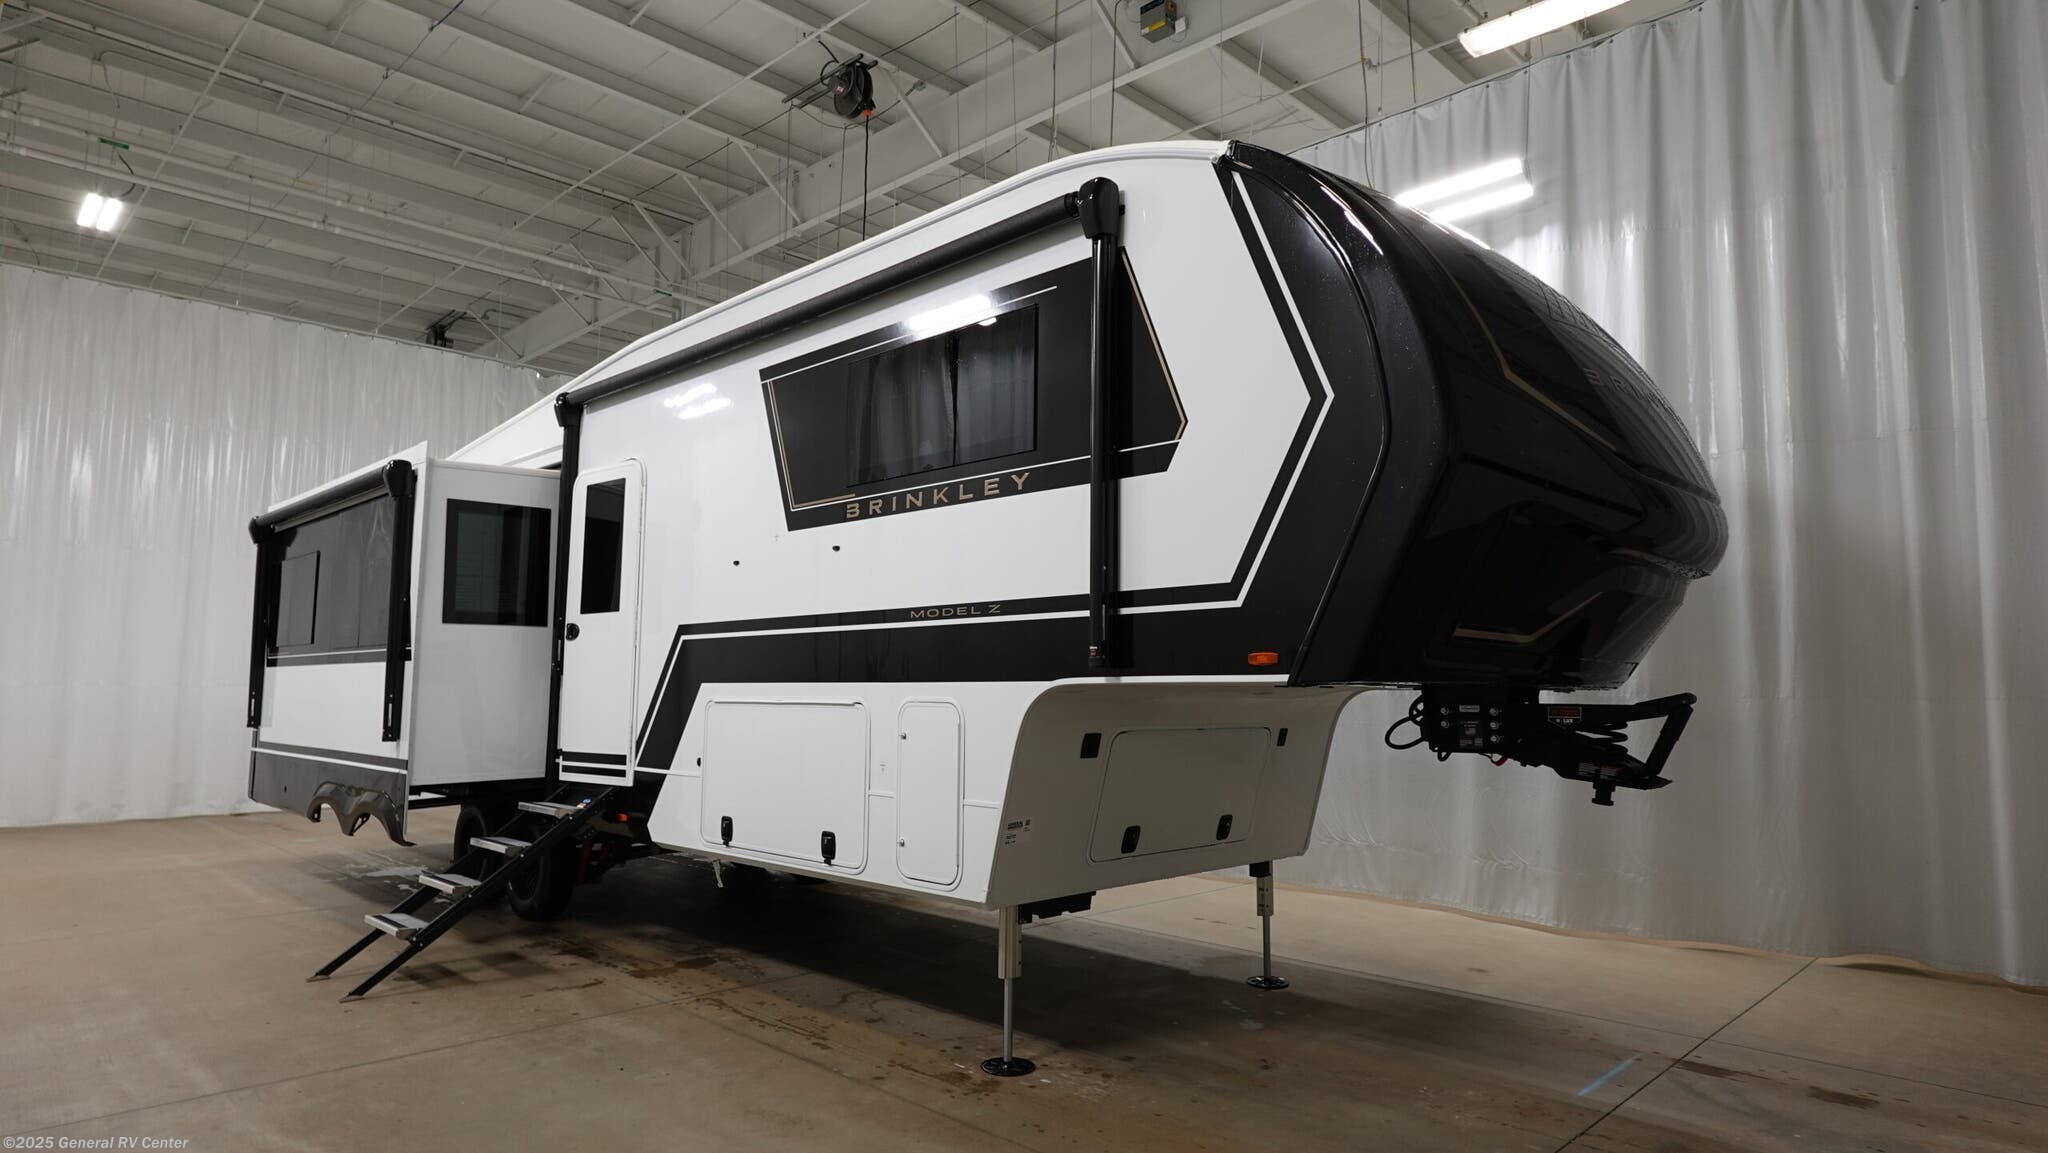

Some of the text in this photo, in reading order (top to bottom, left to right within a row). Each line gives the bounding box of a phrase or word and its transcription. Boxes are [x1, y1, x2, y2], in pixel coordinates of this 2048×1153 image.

[846, 472, 1030, 518] BRINKLEY
[910, 604, 1001, 619] MODEL Z
